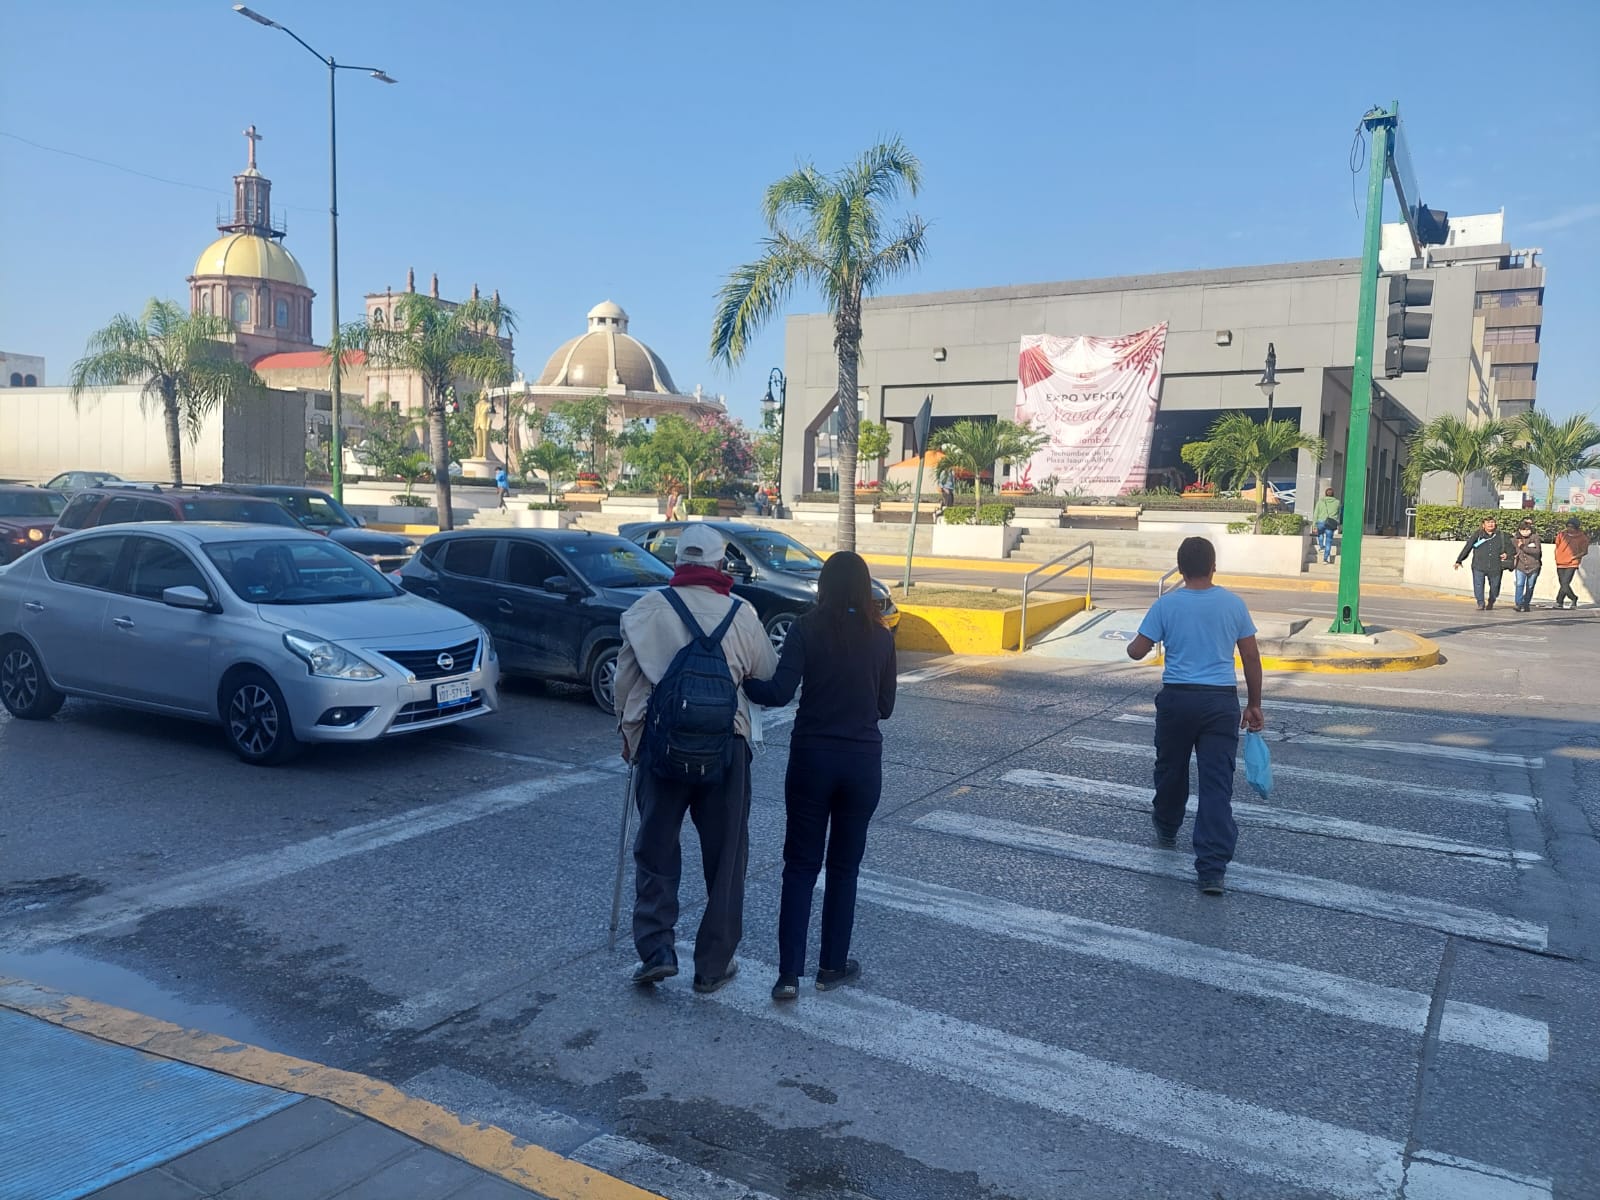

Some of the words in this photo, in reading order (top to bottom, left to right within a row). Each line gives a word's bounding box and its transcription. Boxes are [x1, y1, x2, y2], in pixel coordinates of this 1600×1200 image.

[1046, 393, 1078, 402] EXPO
[1083, 391, 1125, 401] VENTA
[1035, 404, 1133, 421] Navideño
[1095, 427, 1108, 435] 24
